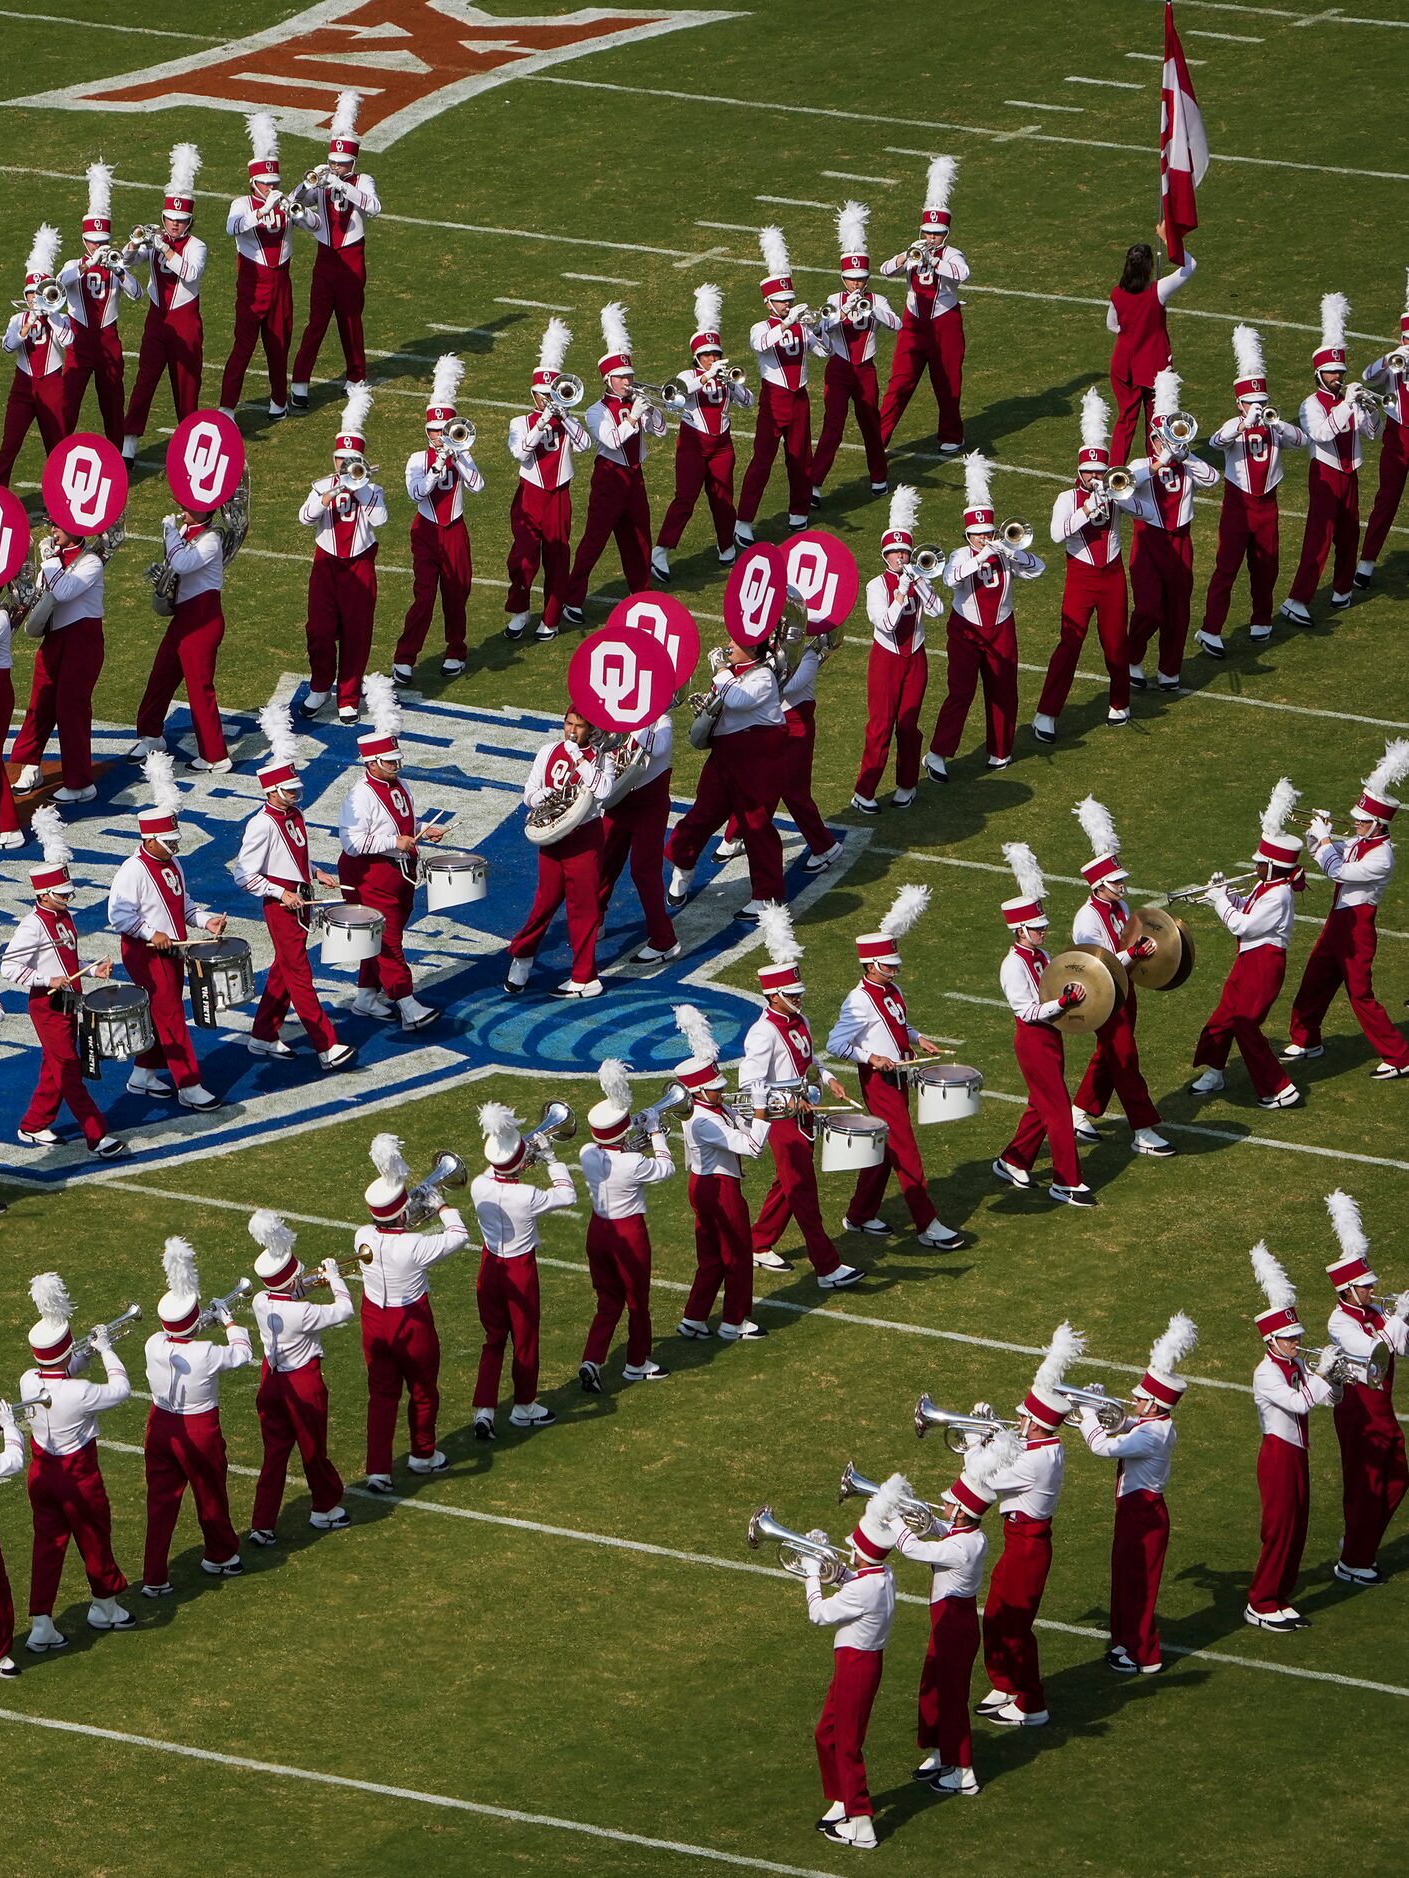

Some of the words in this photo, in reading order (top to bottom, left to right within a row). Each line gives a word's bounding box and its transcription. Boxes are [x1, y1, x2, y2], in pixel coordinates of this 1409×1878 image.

[336, 140, 343, 152] OU
[265, 161, 273, 172] OU
[174, 198, 181, 210] OU
[94, 219, 101, 230] OU
[930, 211, 938, 222] OU
[852, 257, 860, 267] OU
[86, 272, 106, 299] OU
[780, 279, 789, 290] OU
[28, 320, 46, 344] OU
[706, 333, 714, 343] OU
[620, 354, 628, 365] OU
[1332, 350, 1340, 361] OU
[542, 371, 551, 383] OU
[1251, 379, 1260, 391] OU
[435, 408, 443, 419] OU
[344, 436, 352, 448] OU
[1248, 434, 1267, 461] OU
[184, 421, 230, 504] OU
[1088, 449, 1097, 460] OU
[61, 445, 112, 528] OU
[1158, 466, 1181, 492] OU
[337, 493, 356, 522] OU
[976, 512, 985, 522] OU
[894, 531, 902, 542] OU
[786, 540, 839, 623] OU
[977, 562, 999, 588] OU
[739, 554, 776, 638] OU
[590, 641, 653, 723] OU
[550, 760, 570, 789] OU
[391, 790, 410, 816] OU
[1358, 793, 1367, 807] OU
[286, 819, 305, 847] OU
[1111, 856, 1121, 867] OU
[160, 868, 182, 895] OU
[56, 922, 77, 950] OU
[202, 1001, 210, 1024] FIRTH
[883, 997, 906, 1025] OU
[789, 1029, 810, 1057] OU
[88, 1050, 96, 1074] FIRTH
[1285, 1311, 1295, 1321] OU
